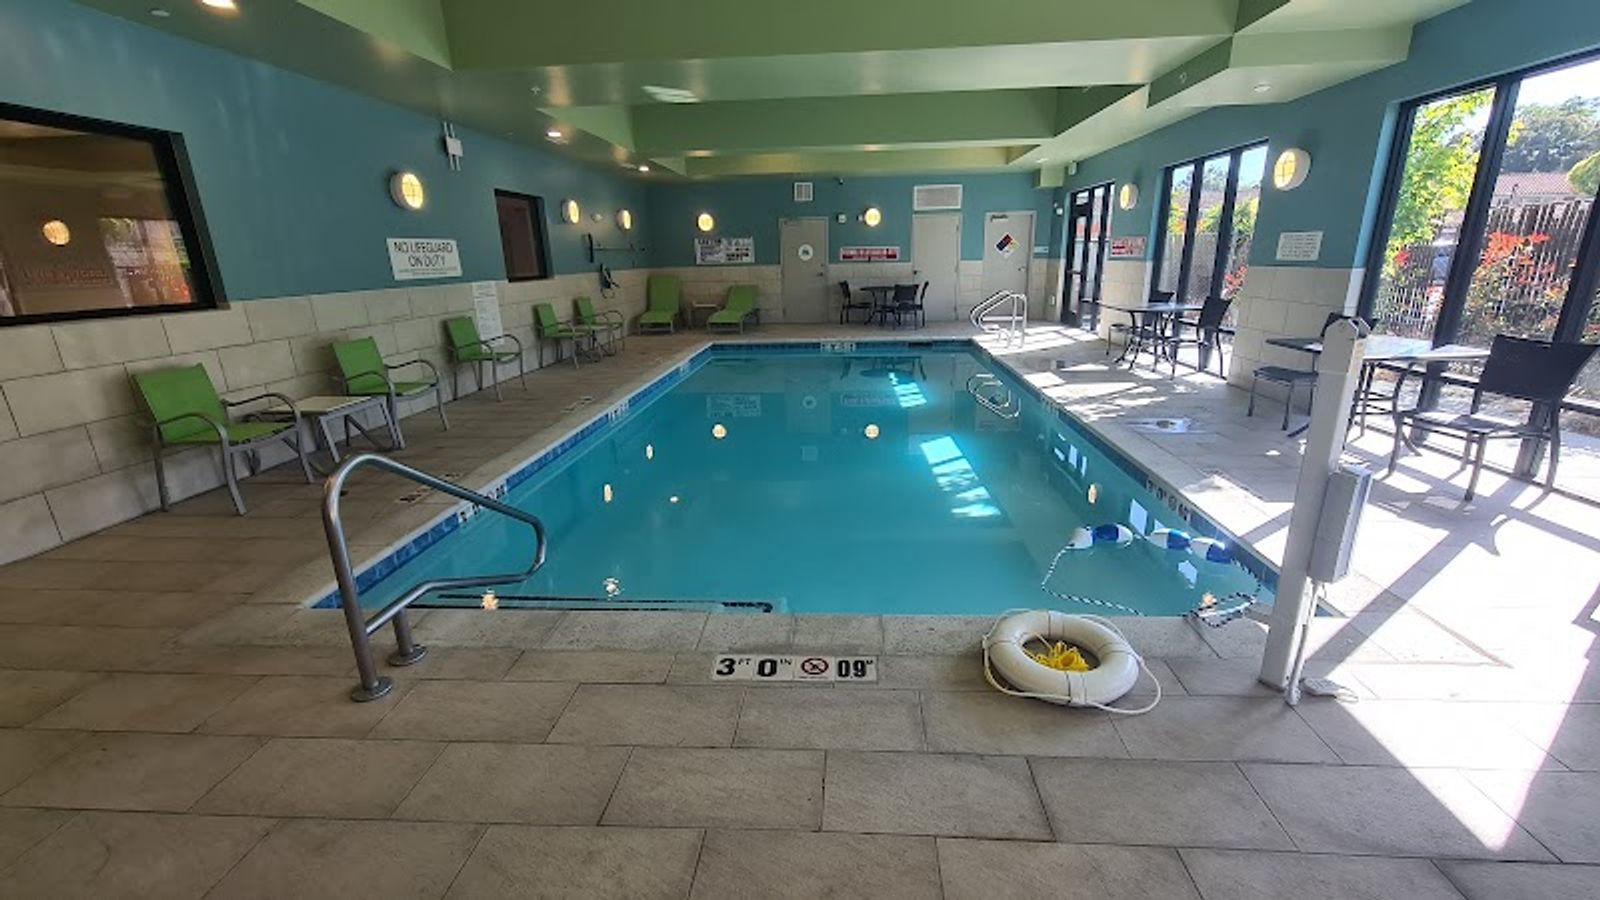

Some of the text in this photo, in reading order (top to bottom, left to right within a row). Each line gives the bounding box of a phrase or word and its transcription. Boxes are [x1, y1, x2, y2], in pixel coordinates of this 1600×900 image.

[394, 242, 453, 253] NO LIFEGUARD
[408, 254, 445, 267] ON DUTY
[716, 658, 736, 676] 3
[757, 659, 778, 677] 0
